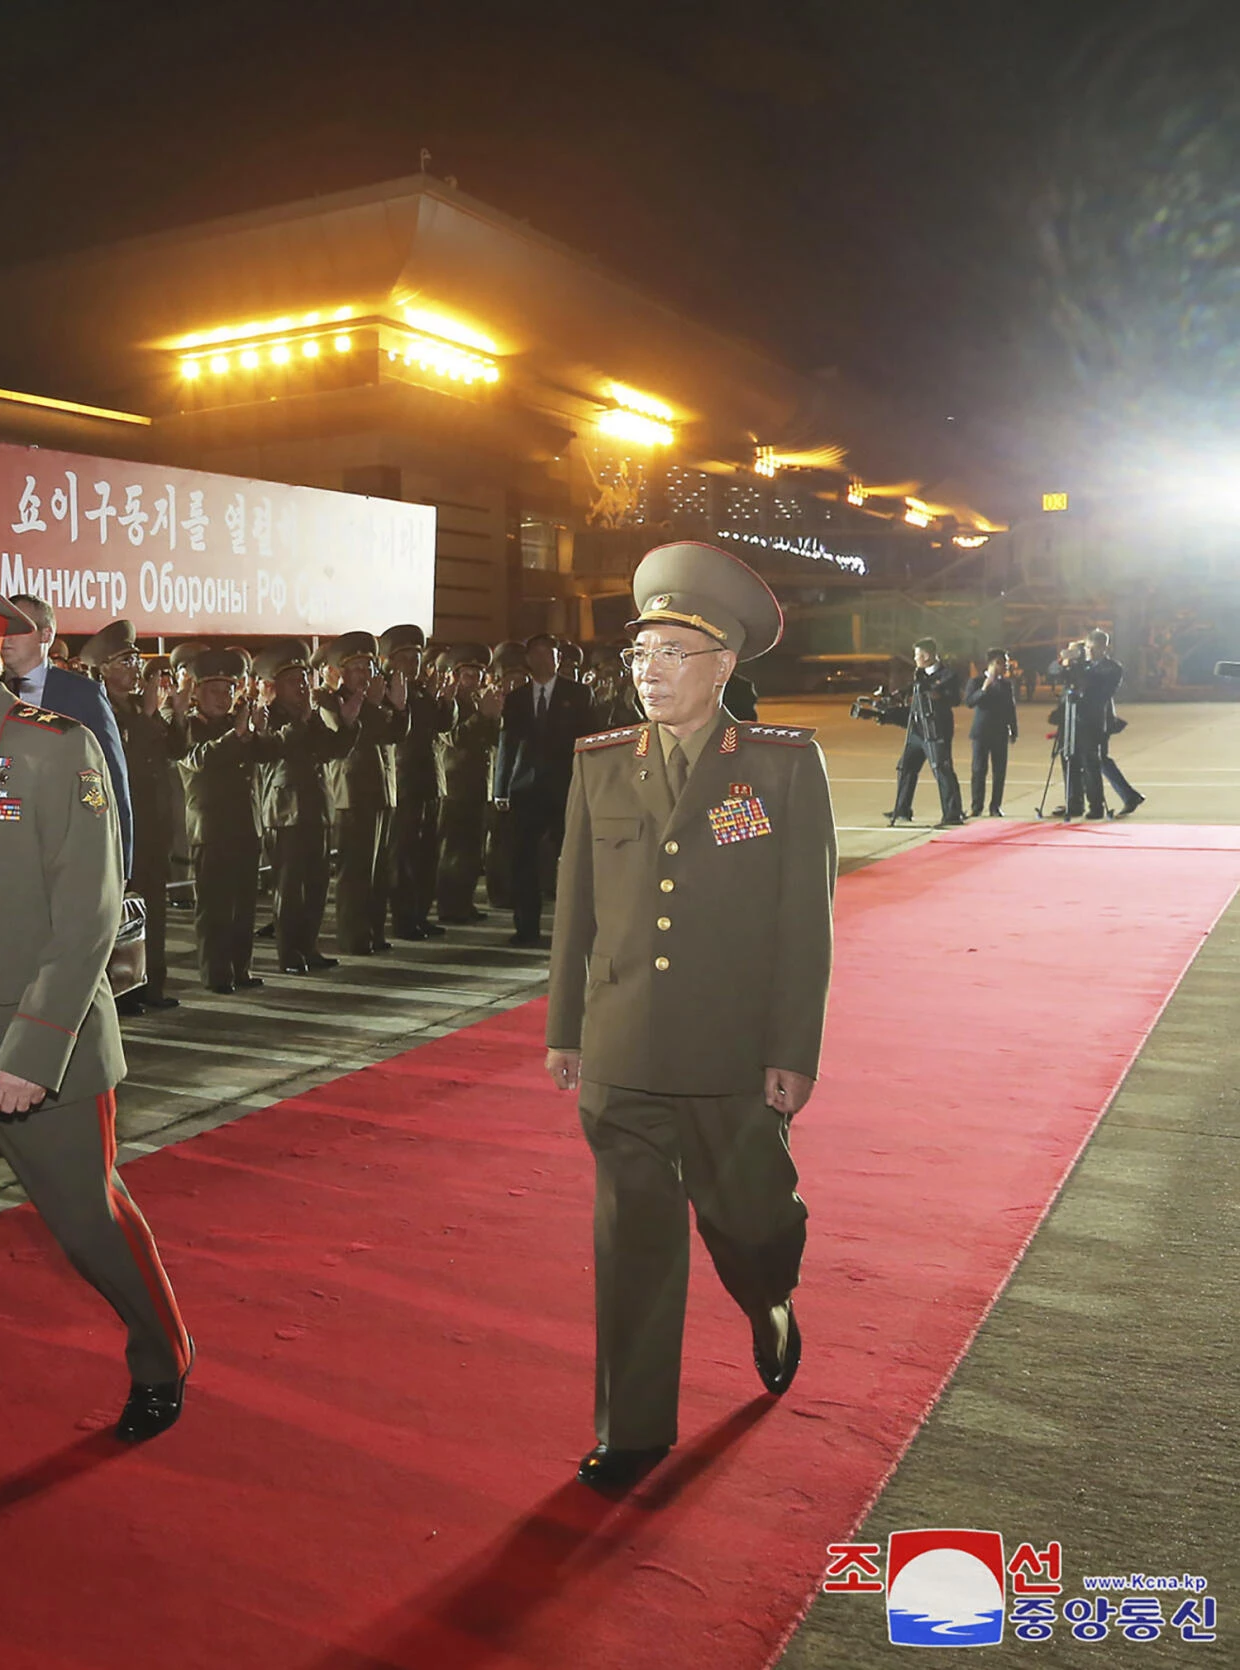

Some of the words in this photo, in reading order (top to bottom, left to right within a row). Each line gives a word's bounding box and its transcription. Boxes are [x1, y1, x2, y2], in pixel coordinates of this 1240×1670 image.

[10, 471, 210, 552] 쇼이구동지를
[0, 553, 127, 616] Министр
[140, 560, 247, 618] Обороны
[257, 569, 287, 616] РФ
